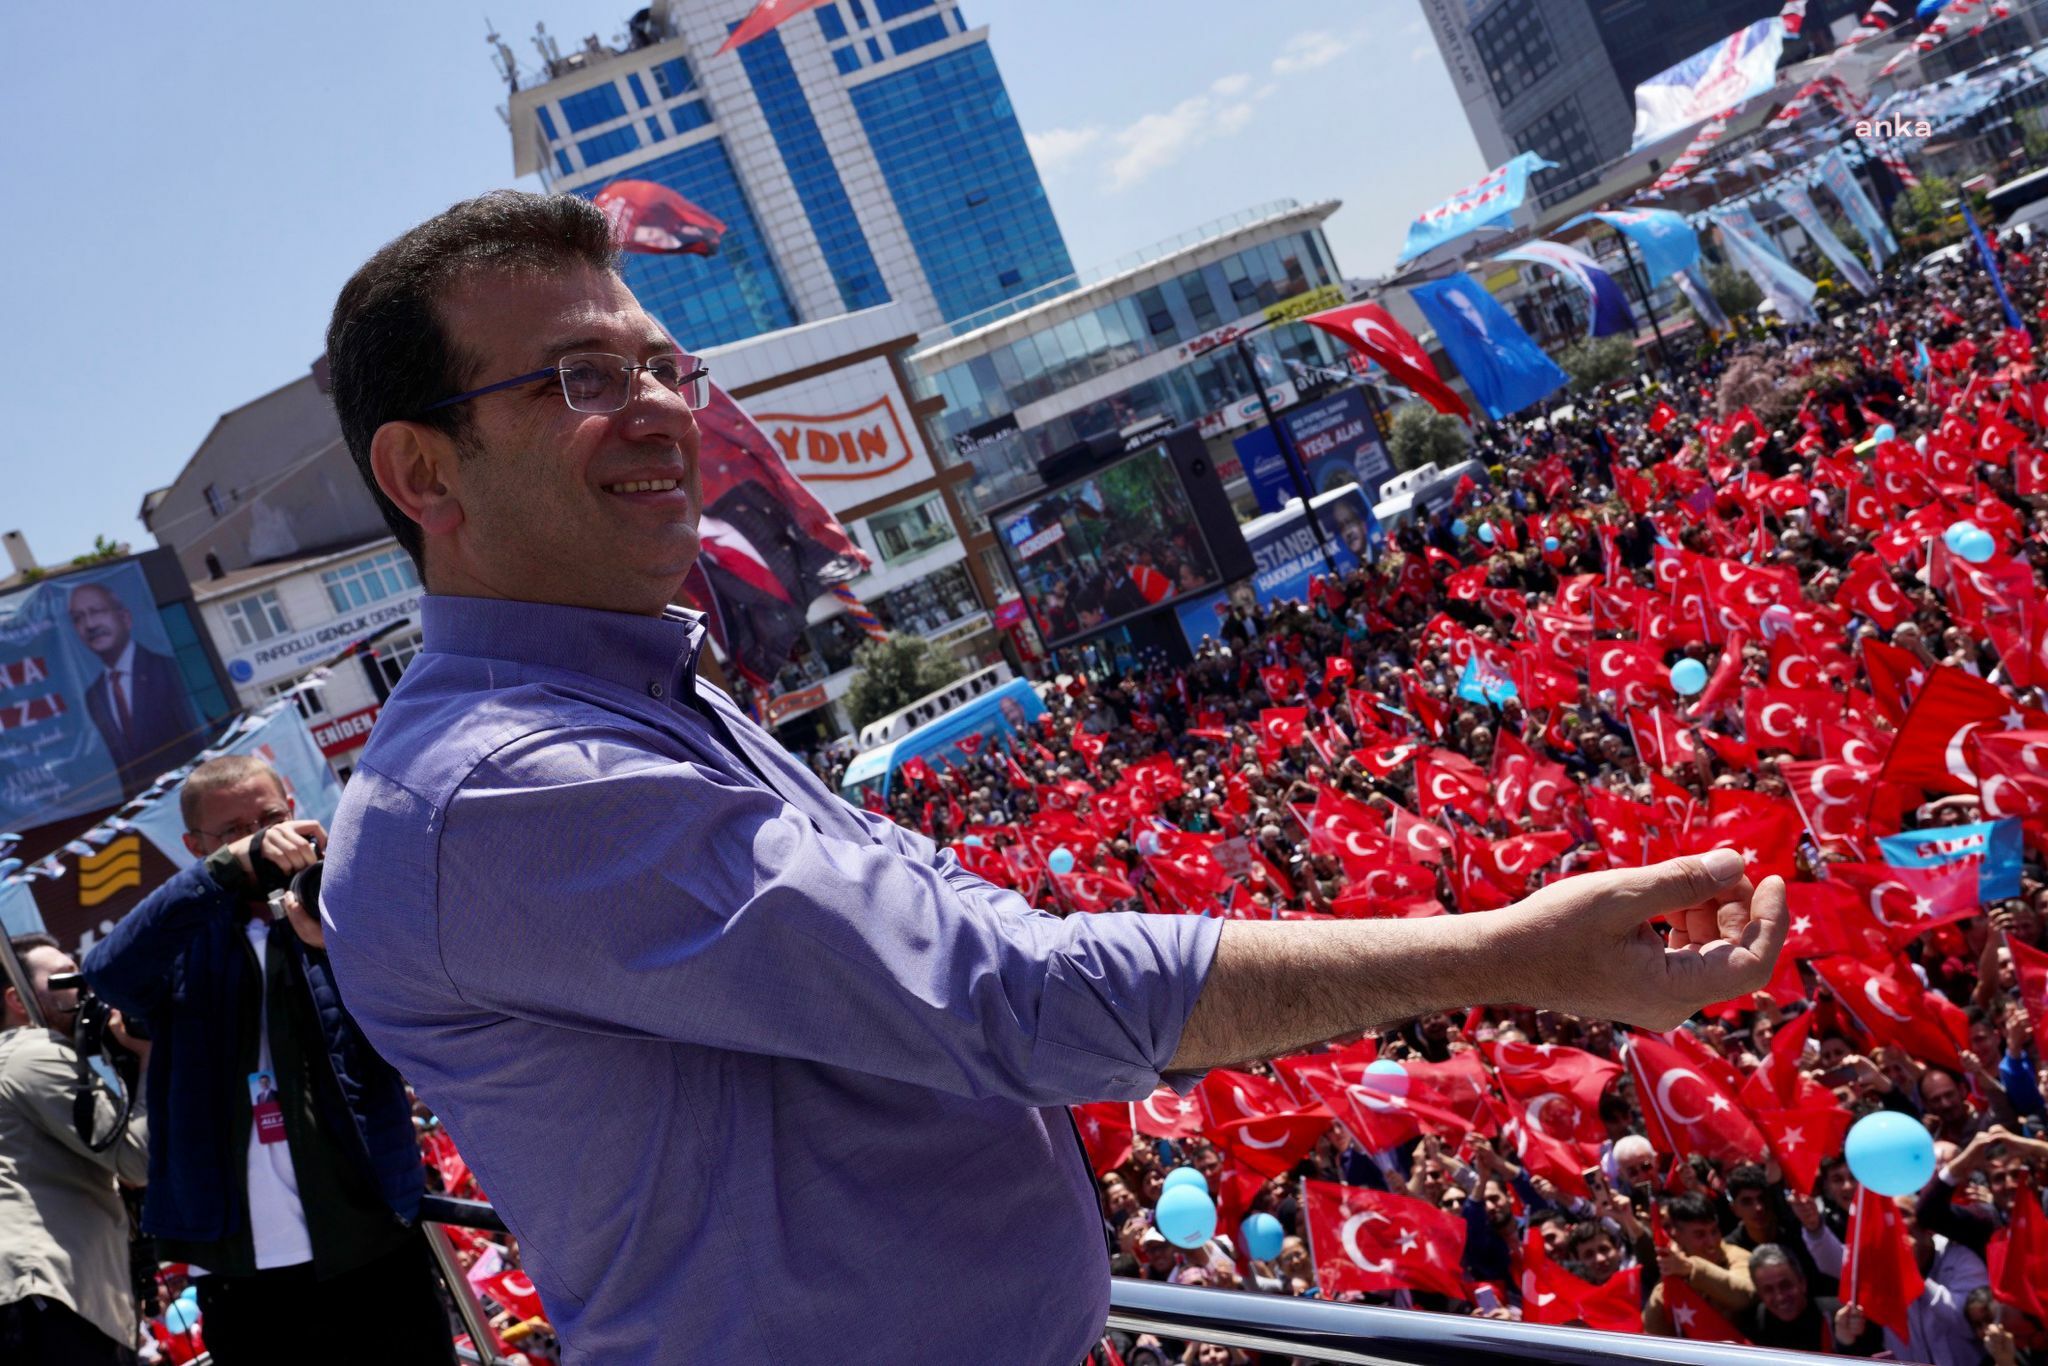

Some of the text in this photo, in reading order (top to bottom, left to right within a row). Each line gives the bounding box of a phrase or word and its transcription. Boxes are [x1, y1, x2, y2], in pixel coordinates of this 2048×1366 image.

[773, 424, 888, 464] YDIN
[1302, 432, 1335, 459] YEŞİL
[1335, 420, 1364, 445] ALAN
[1252, 519, 1334, 574] STANBL
[254, 635, 315, 666] ANADOLU
[371, 599, 420, 626] DERNEĞ
[315, 713, 374, 749] ENİDEN
